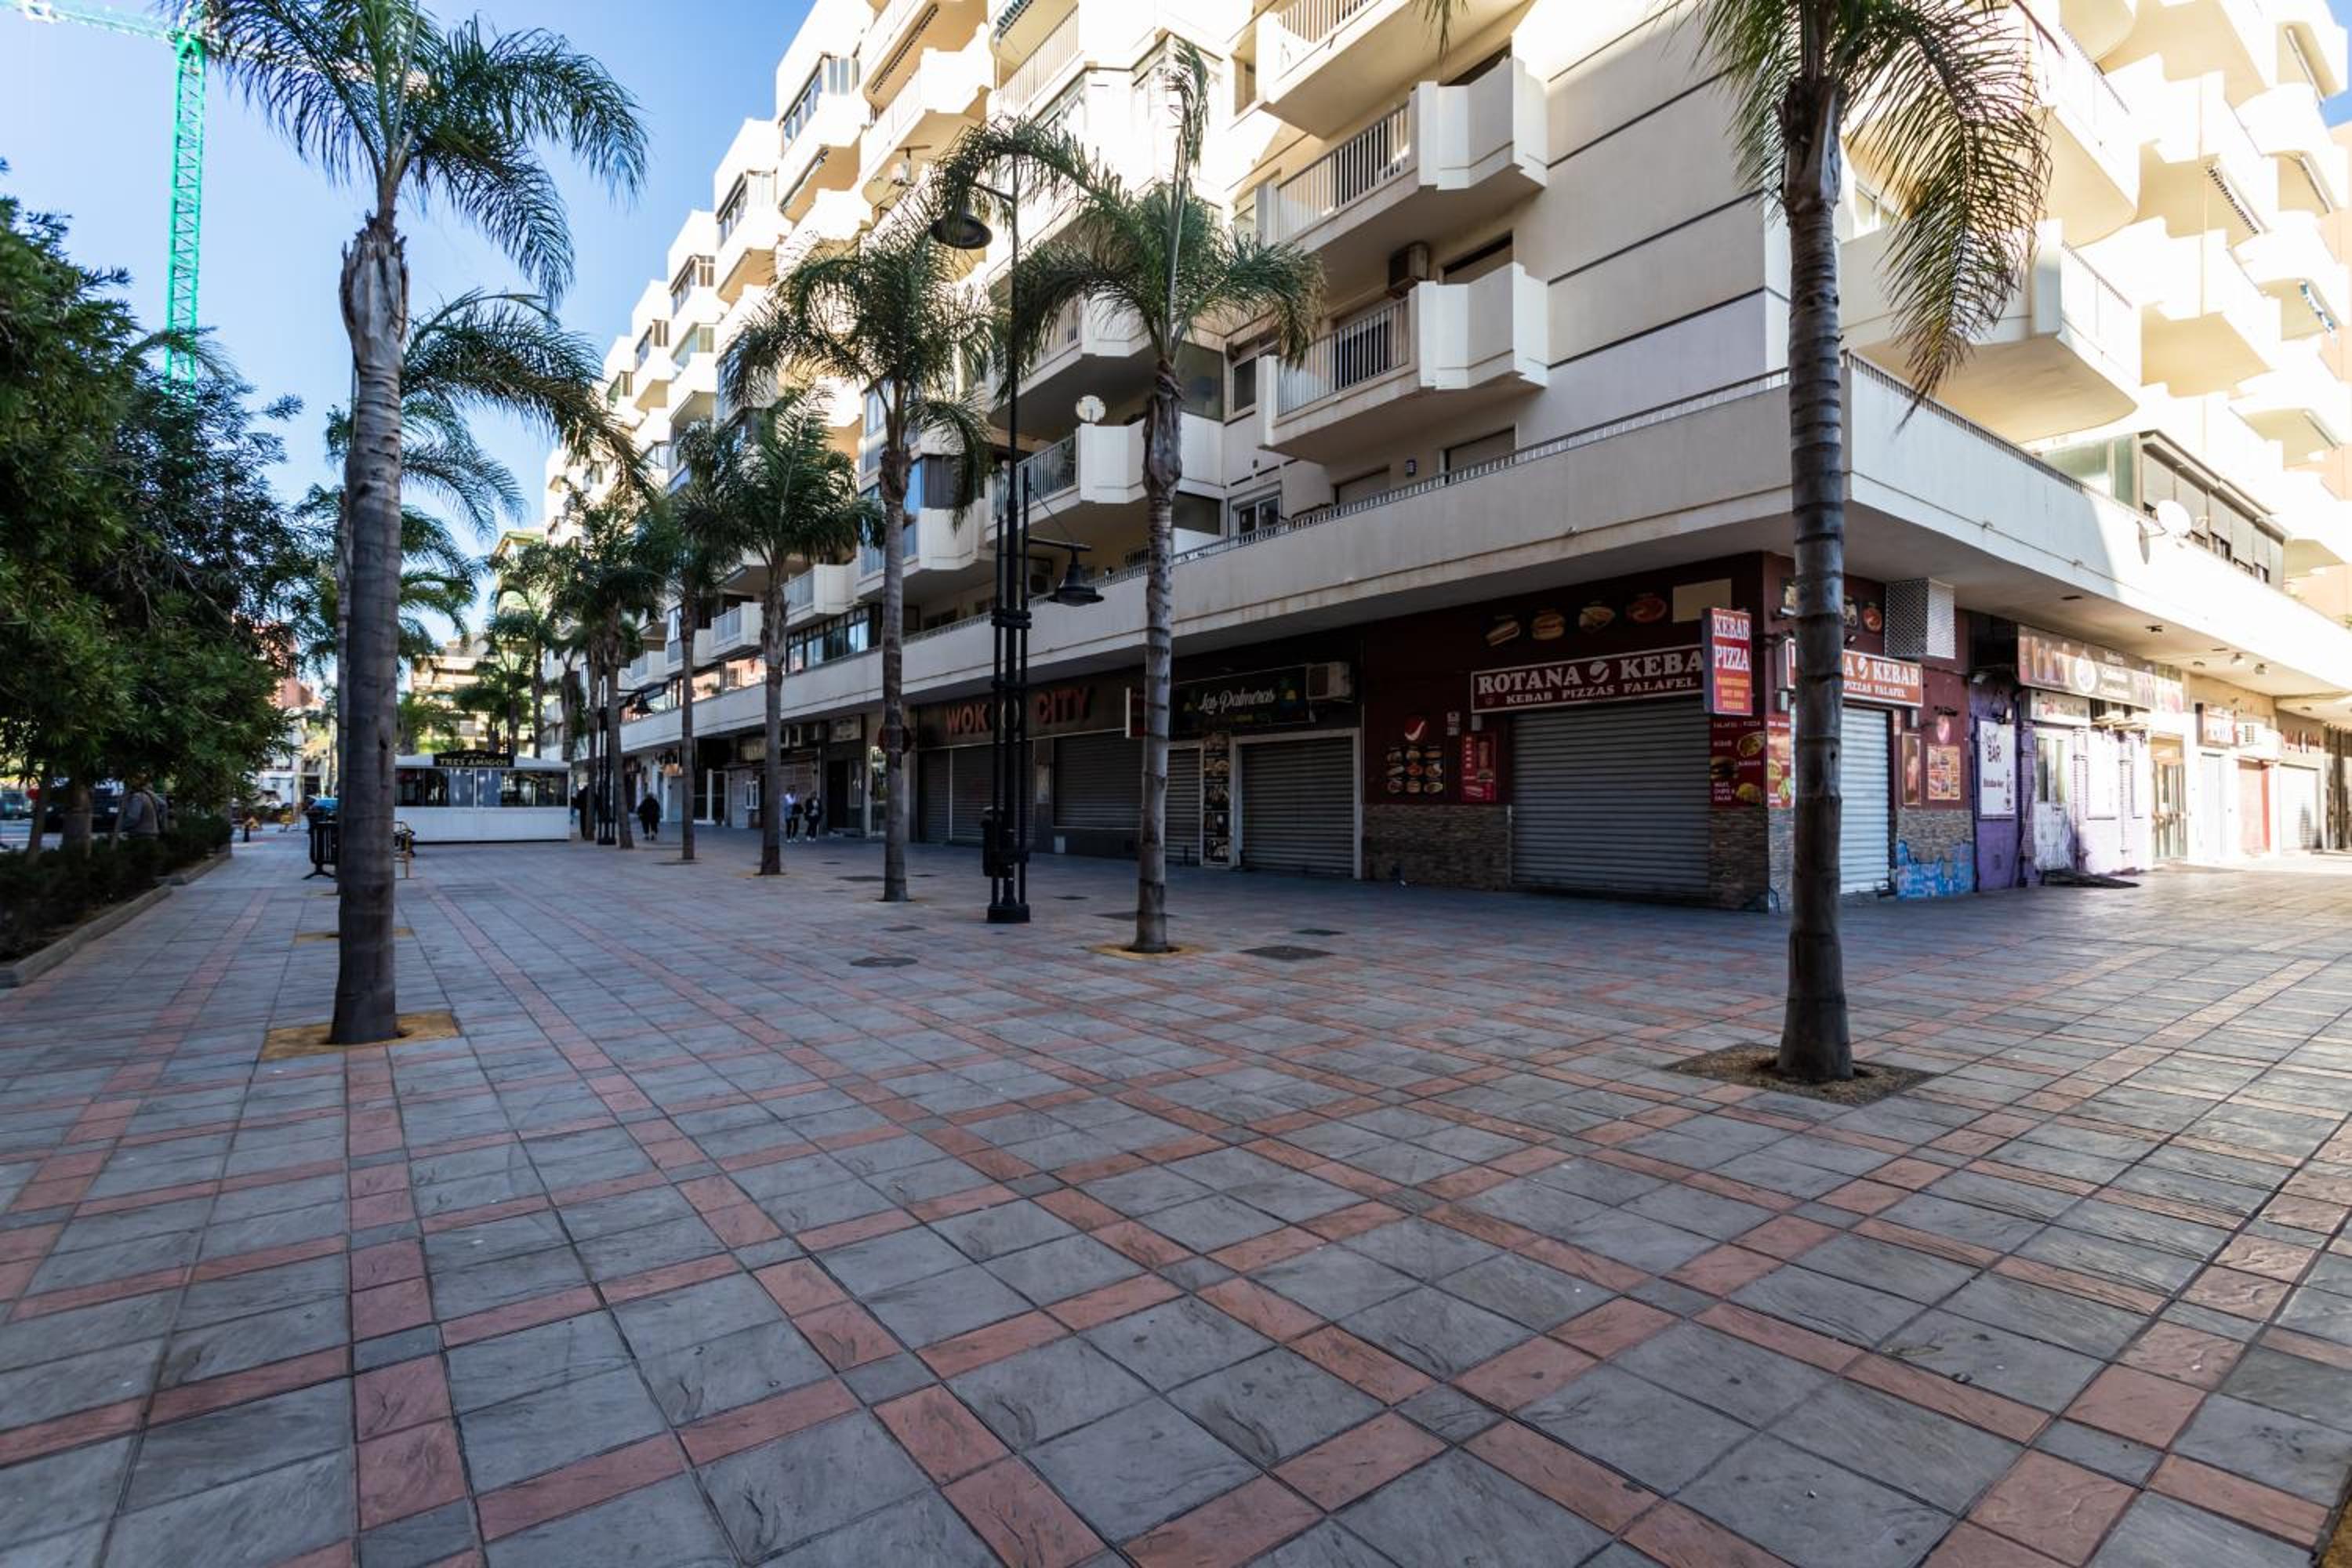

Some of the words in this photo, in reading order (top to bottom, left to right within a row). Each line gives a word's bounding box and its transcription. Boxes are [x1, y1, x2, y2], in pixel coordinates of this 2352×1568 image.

[1713, 614, 1749, 641] KEBAB
[1714, 644, 1750, 671] PIZZA
[1478, 666, 1583, 695] ROTANA
[1619, 650, 1704, 680] KEBA
[1871, 660, 1919, 686] KEBAB
[1506, 691, 1553, 705] KEBAB
[1562, 684, 1615, 700] PIZZAS
[1624, 677, 1697, 694] FALAFEL
[1875, 684, 1907, 698] FALAFEL
[946, 702, 992, 735] WOK
[1034, 686, 1094, 725] CITY
